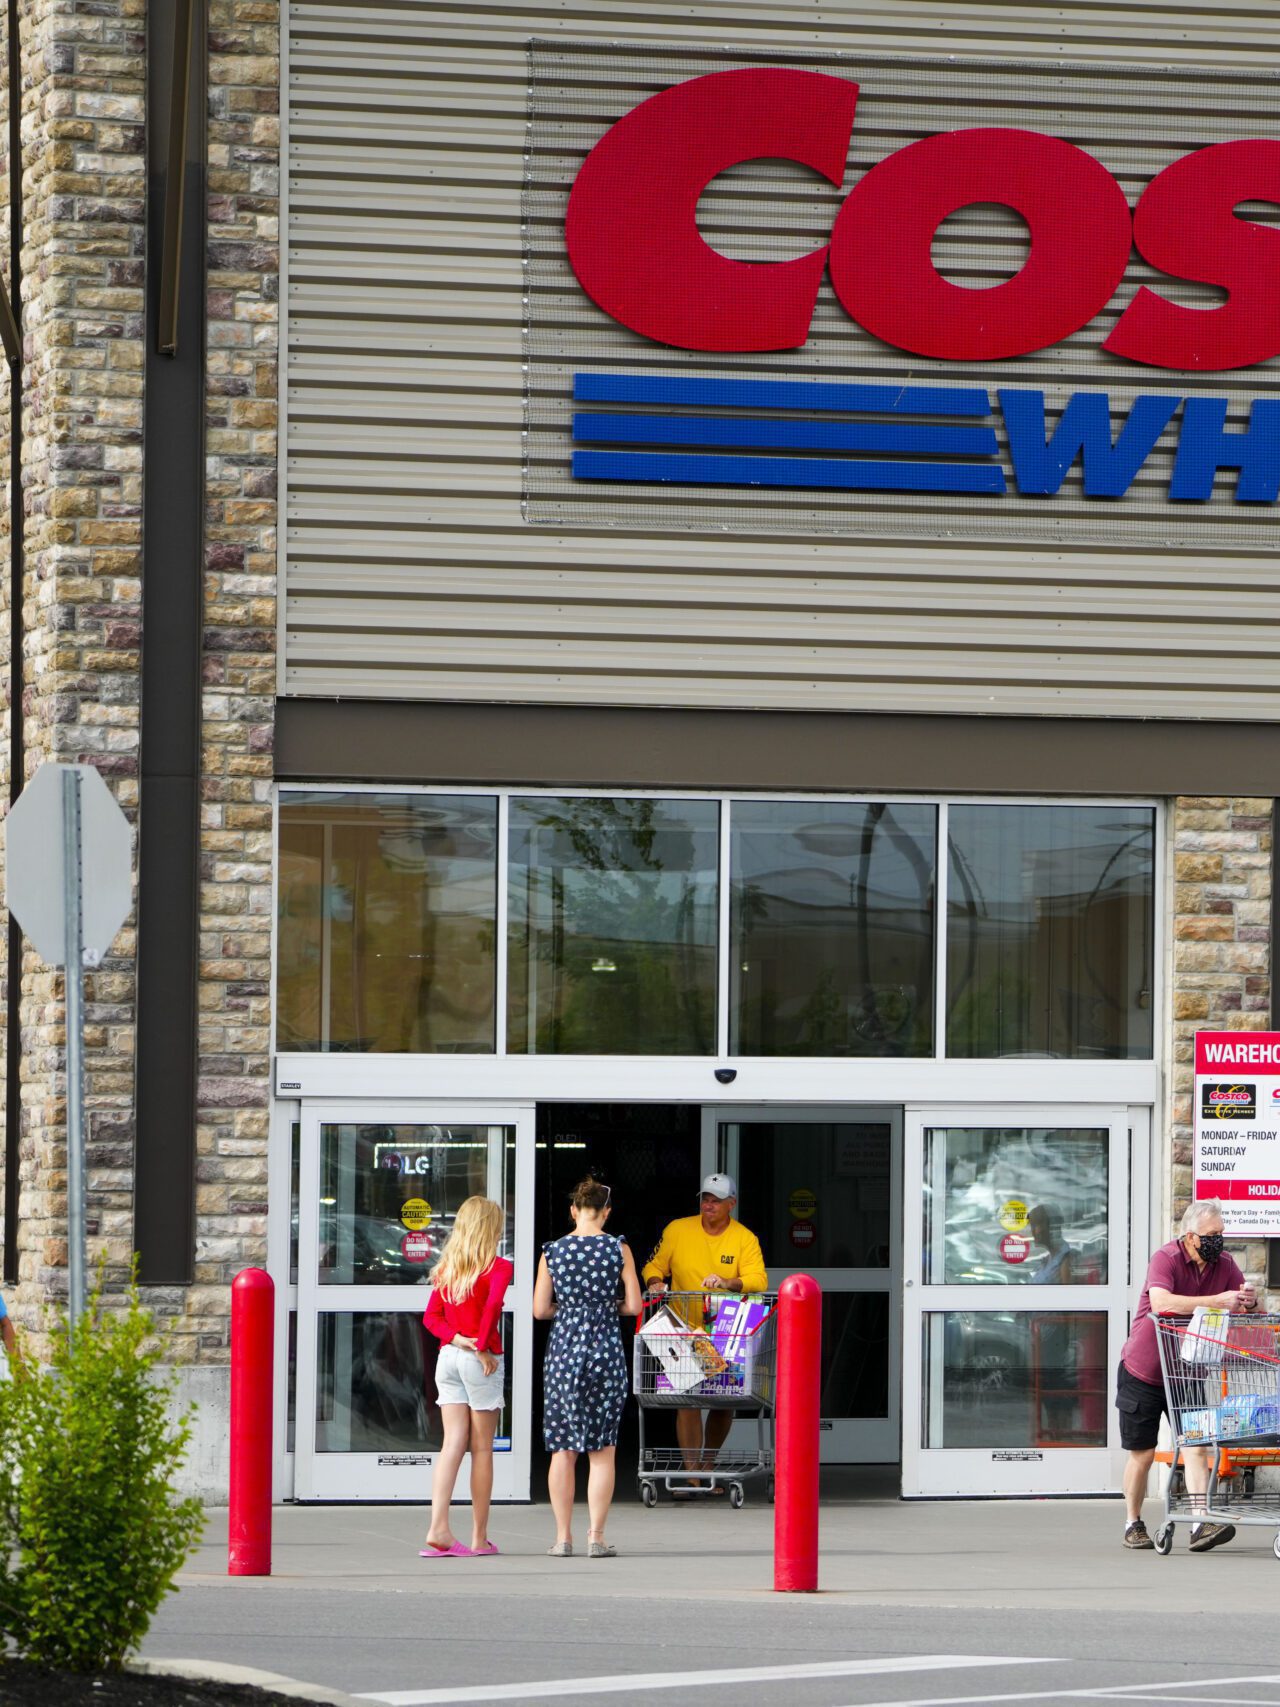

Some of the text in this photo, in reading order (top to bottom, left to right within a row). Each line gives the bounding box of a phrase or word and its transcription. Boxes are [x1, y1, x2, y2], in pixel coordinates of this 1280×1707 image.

[1210, 1091, 1249, 1100] COSTCO
[1201, 1130, 1239, 1140] MONDAY
[1247, 1131, 1278, 1140] FRIDAY
[1201, 1146, 1247, 1156] SATURDAY
[404, 1155, 430, 1175] LG
[1201, 1162, 1236, 1171] SUNDAY
[720, 1255, 735, 1264] CAT
